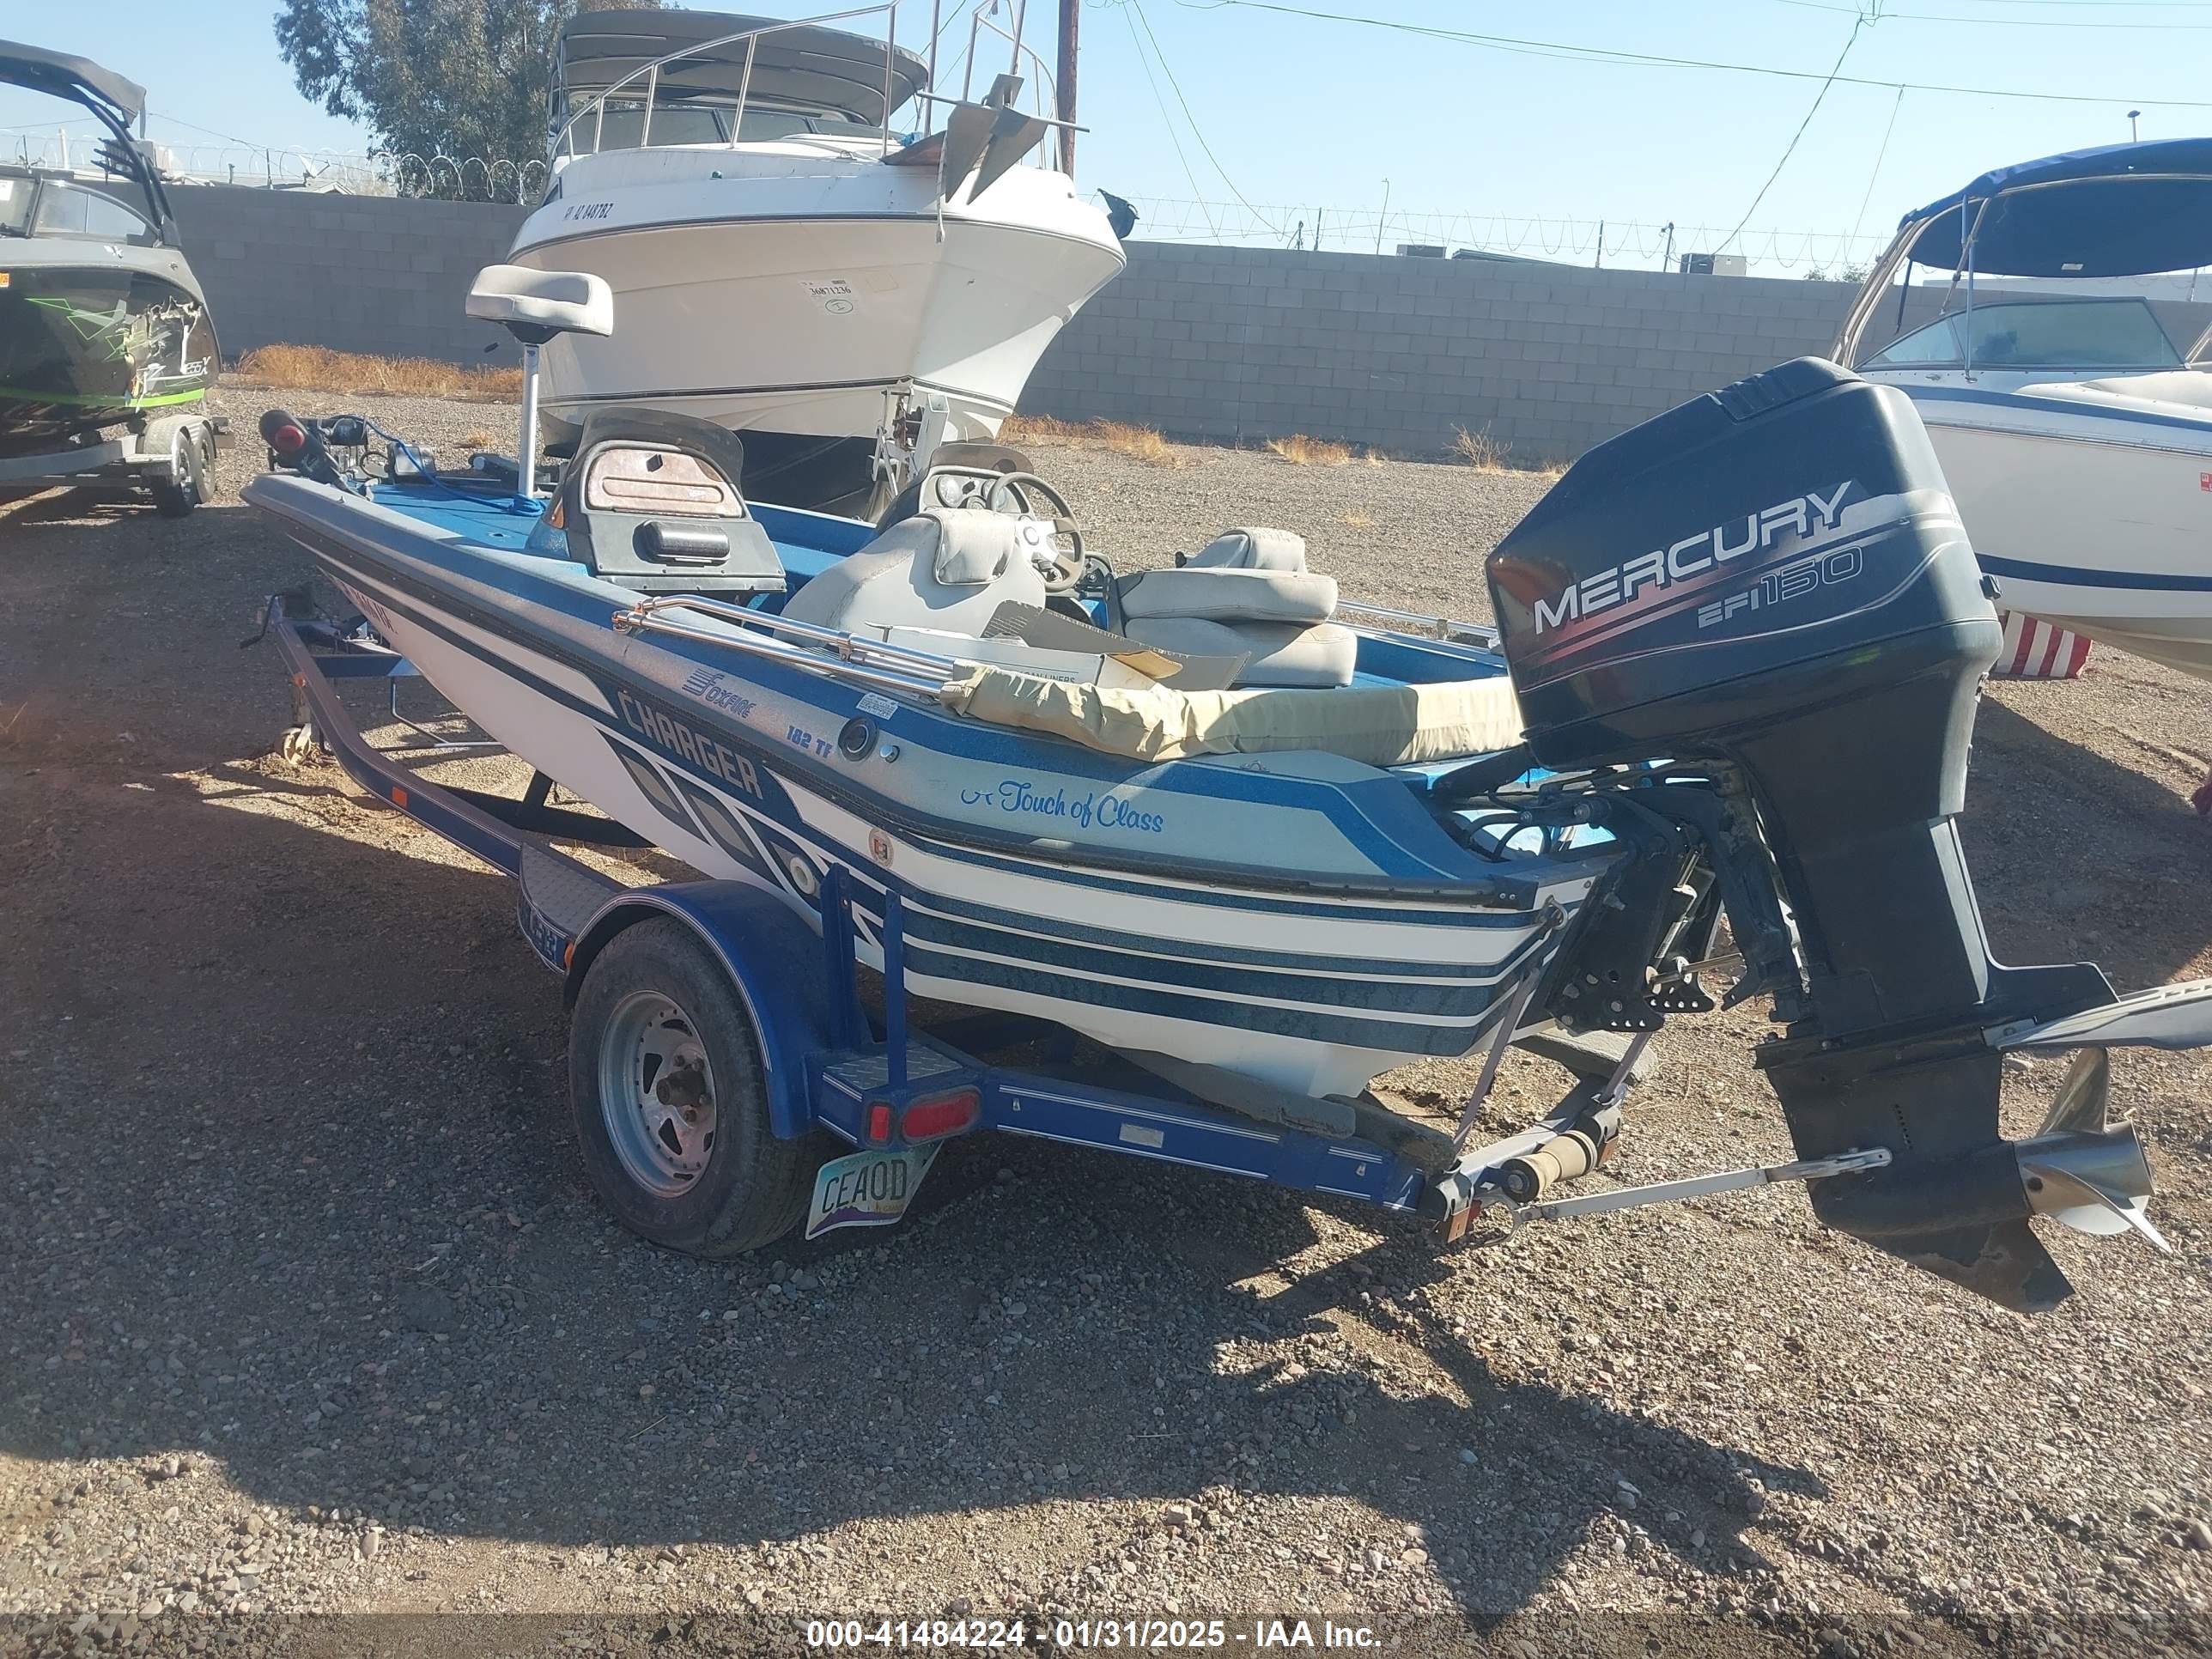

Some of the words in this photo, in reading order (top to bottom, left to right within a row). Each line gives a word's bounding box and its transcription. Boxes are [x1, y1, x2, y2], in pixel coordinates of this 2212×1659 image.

[809, 286, 852, 295] 36871236
[1533, 480, 1853, 635] MERCURY
[618, 690, 763, 800] CHARGER
[787, 725, 812, 750] 182
[998, 780, 1066, 817] Touch
[1070, 792, 1094, 829] of
[1097, 794, 1164, 833] Class
